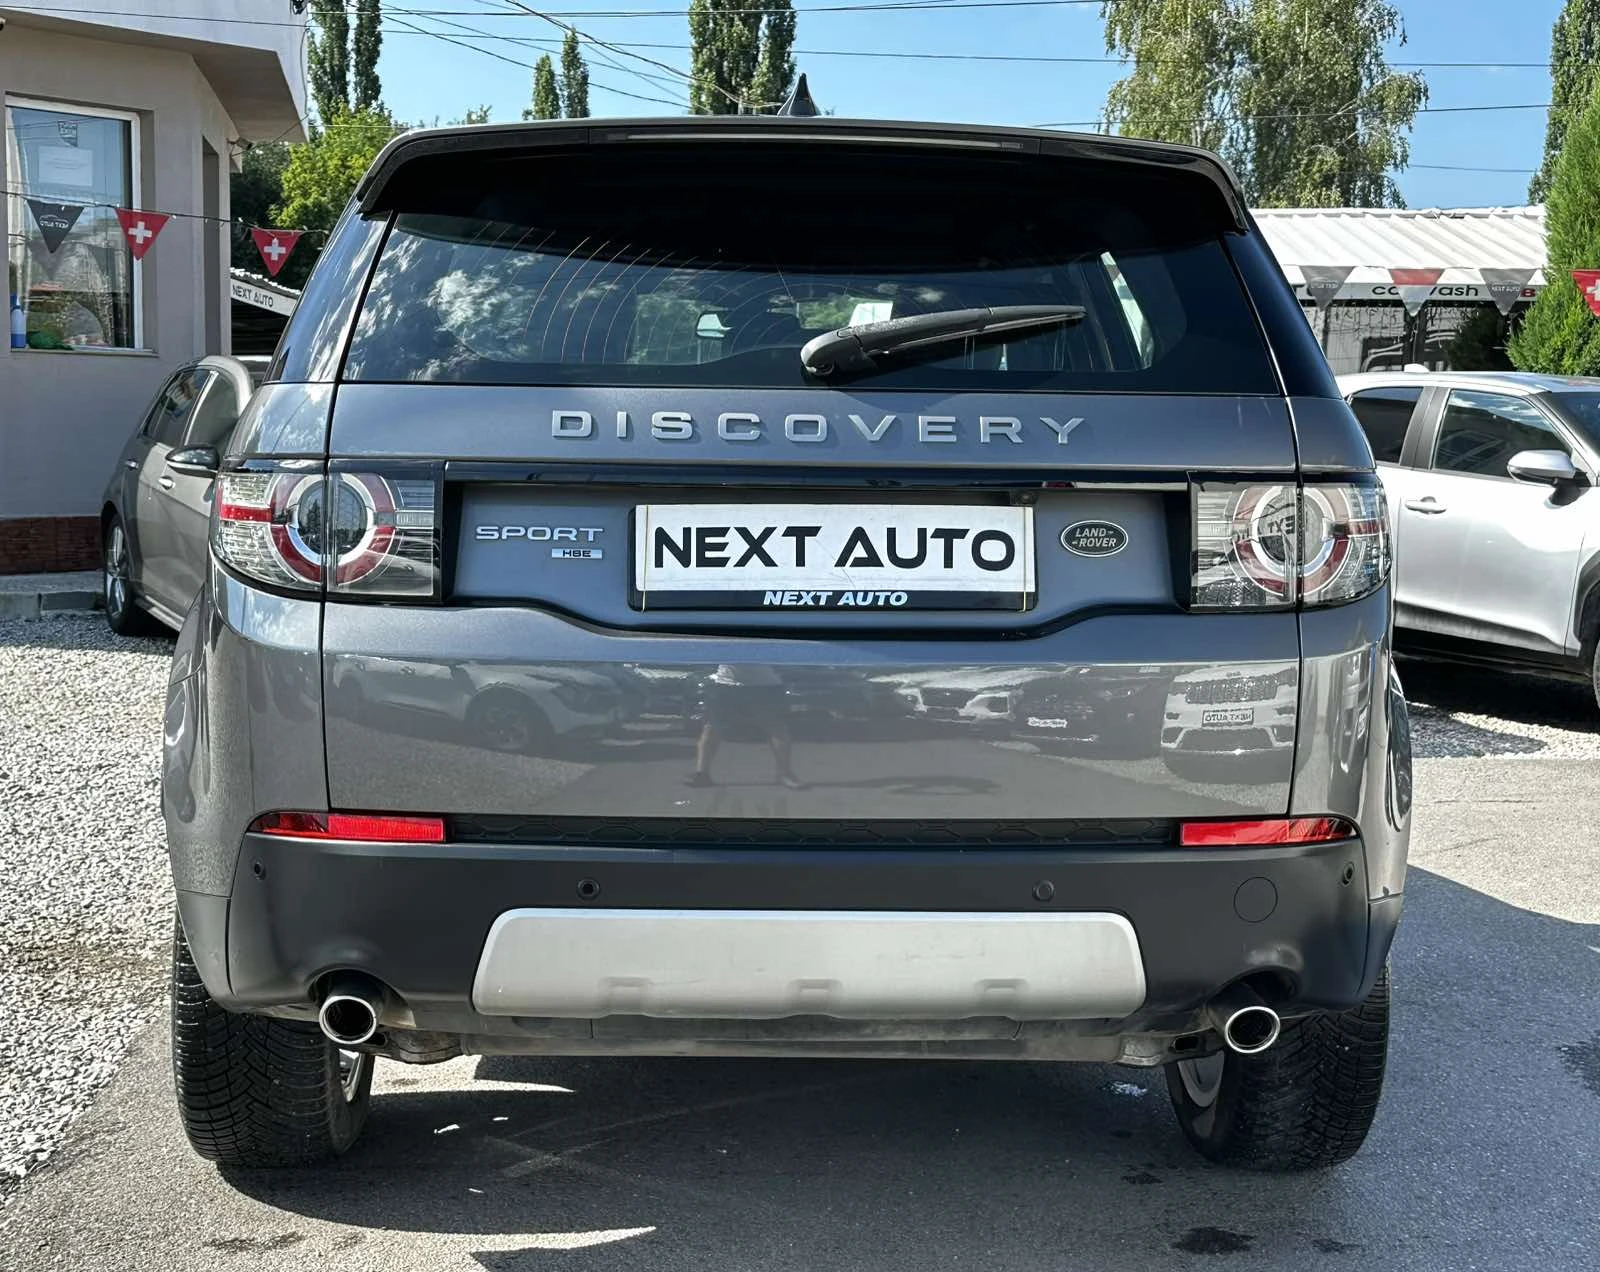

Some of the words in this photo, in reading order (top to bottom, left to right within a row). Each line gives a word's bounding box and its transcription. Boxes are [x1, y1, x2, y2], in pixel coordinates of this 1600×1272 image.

[232, 284, 252, 300] NEXT
[253, 291, 274, 308] AUTO
[551, 409, 1086, 445] DISCOVERY
[475, 525, 604, 542] SPORT
[562, 549, 592, 558] HSE
[653, 525, 823, 569] NEXT
[833, 525, 1016, 572] AUTO
[762, 590, 833, 607] NEXT
[836, 590, 909, 607] AUTO
